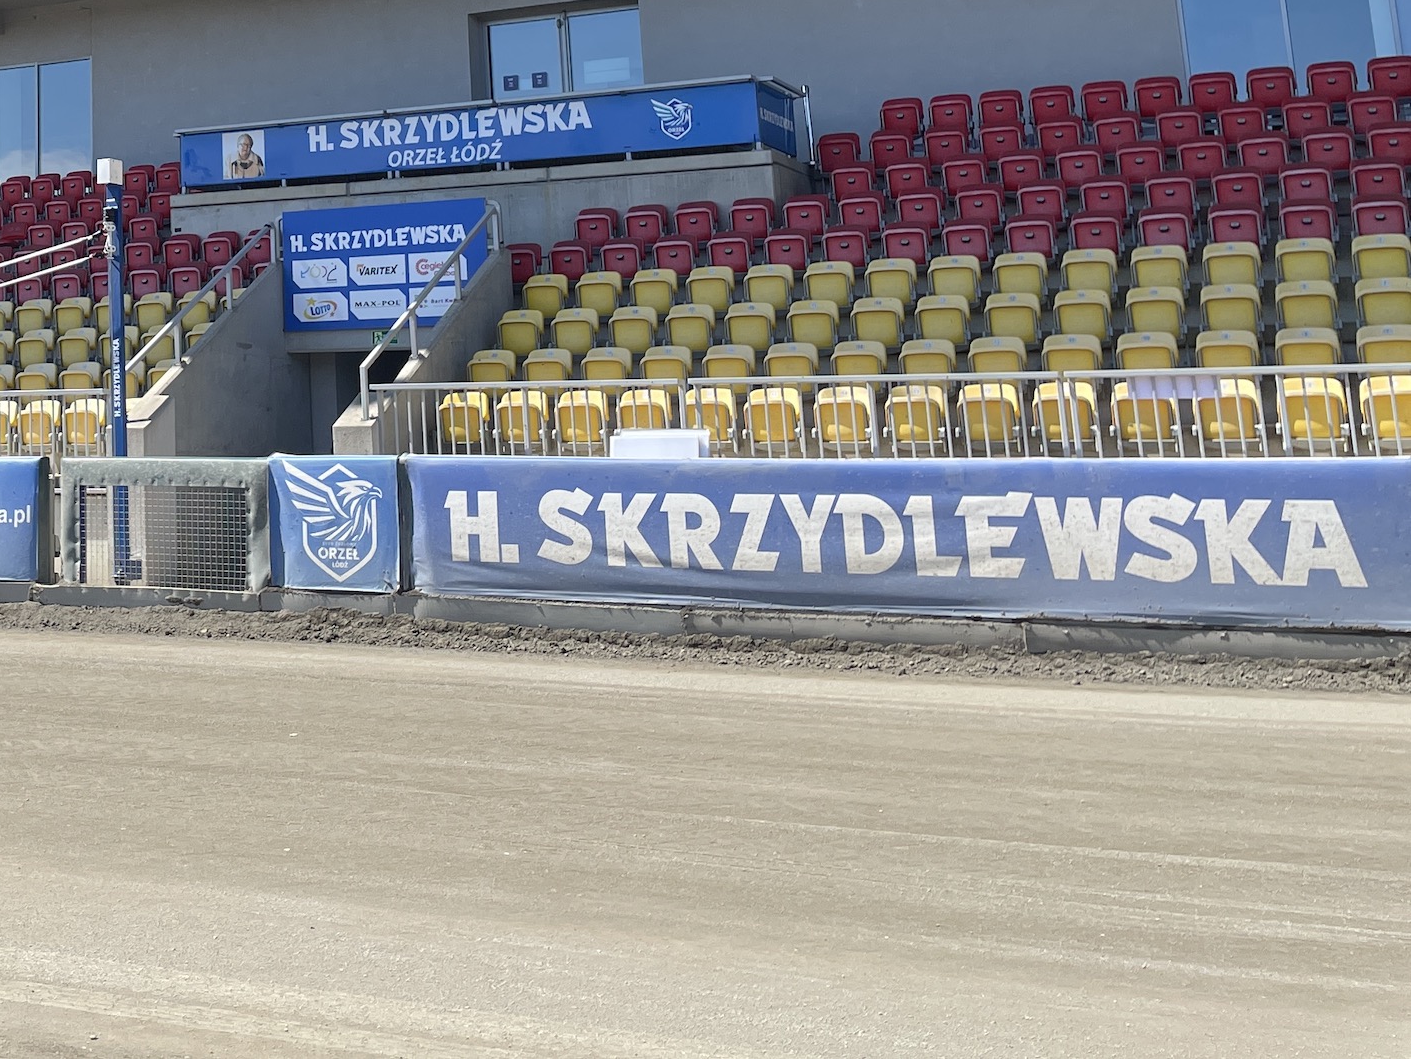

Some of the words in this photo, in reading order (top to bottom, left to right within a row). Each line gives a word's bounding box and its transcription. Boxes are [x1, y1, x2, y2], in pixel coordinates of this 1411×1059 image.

[307, 124, 334, 153] H.
[339, 100, 593, 150] SKRZYDLEWSKA
[388, 149, 447, 168] ORZEŁ
[450, 141, 503, 163] ŁÓDŹ
[290, 234, 308, 253] H.
[310, 223, 467, 252] SKRZYDLEWSKA
[358, 264, 399, 276] VARITEX
[310, 304, 331, 316] LOTTO
[354, 299, 401, 308] MAX-POL
[112, 338, 121, 408] SKRZYDLEWSKA
[444, 490, 520, 564] H.
[537, 486, 1369, 588] SKRZYDLEWSKA
[317, 546, 360, 560] ORZEŁ
